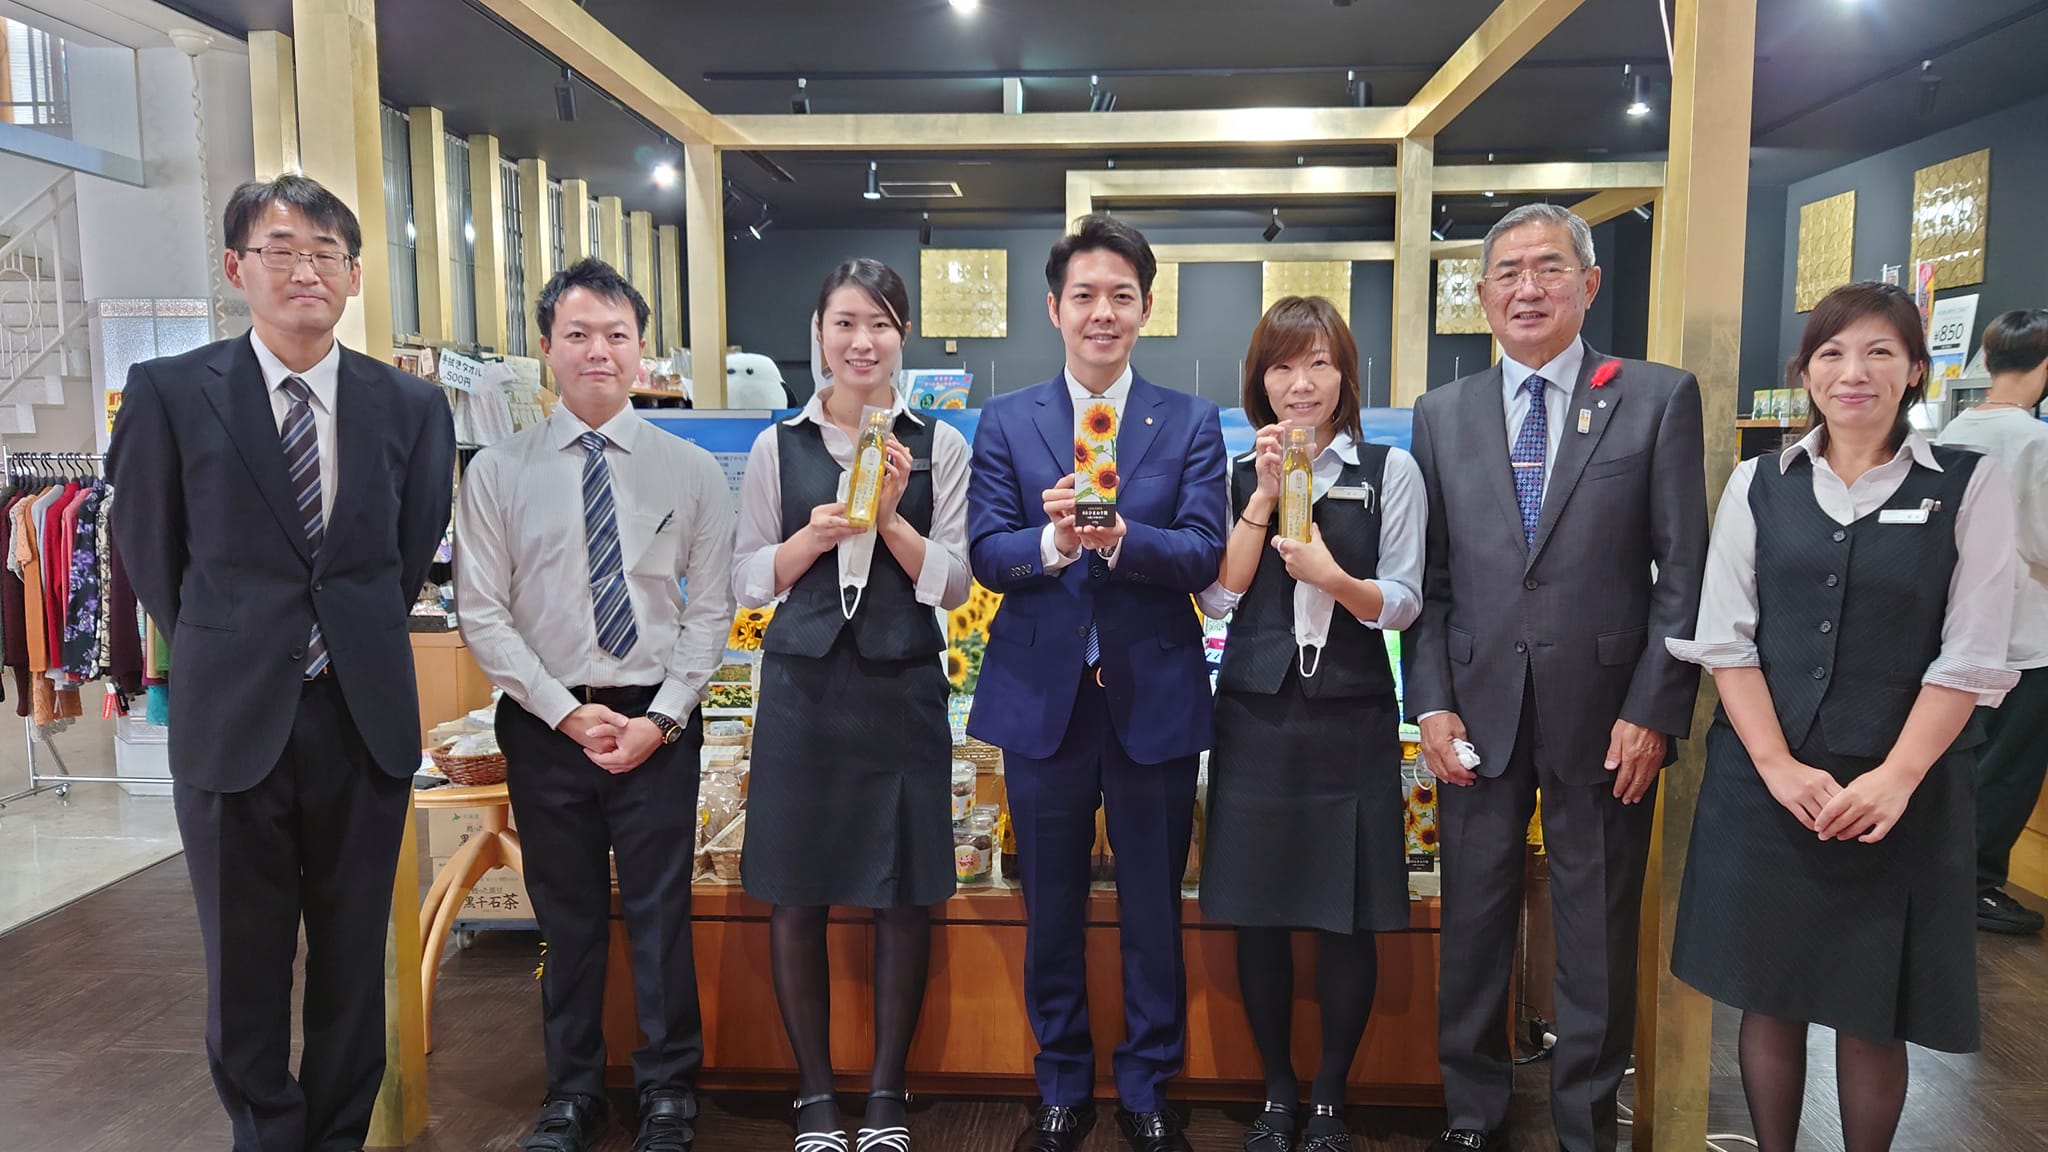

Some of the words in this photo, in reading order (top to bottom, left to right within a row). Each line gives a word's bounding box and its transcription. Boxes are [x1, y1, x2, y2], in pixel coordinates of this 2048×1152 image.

[1934, 323, 1965, 342] ¥850
[442, 354, 482, 377] 手拭きタオル
[446, 370, 471, 388] 500円
[463, 893, 520, 911] 黒千石茶
